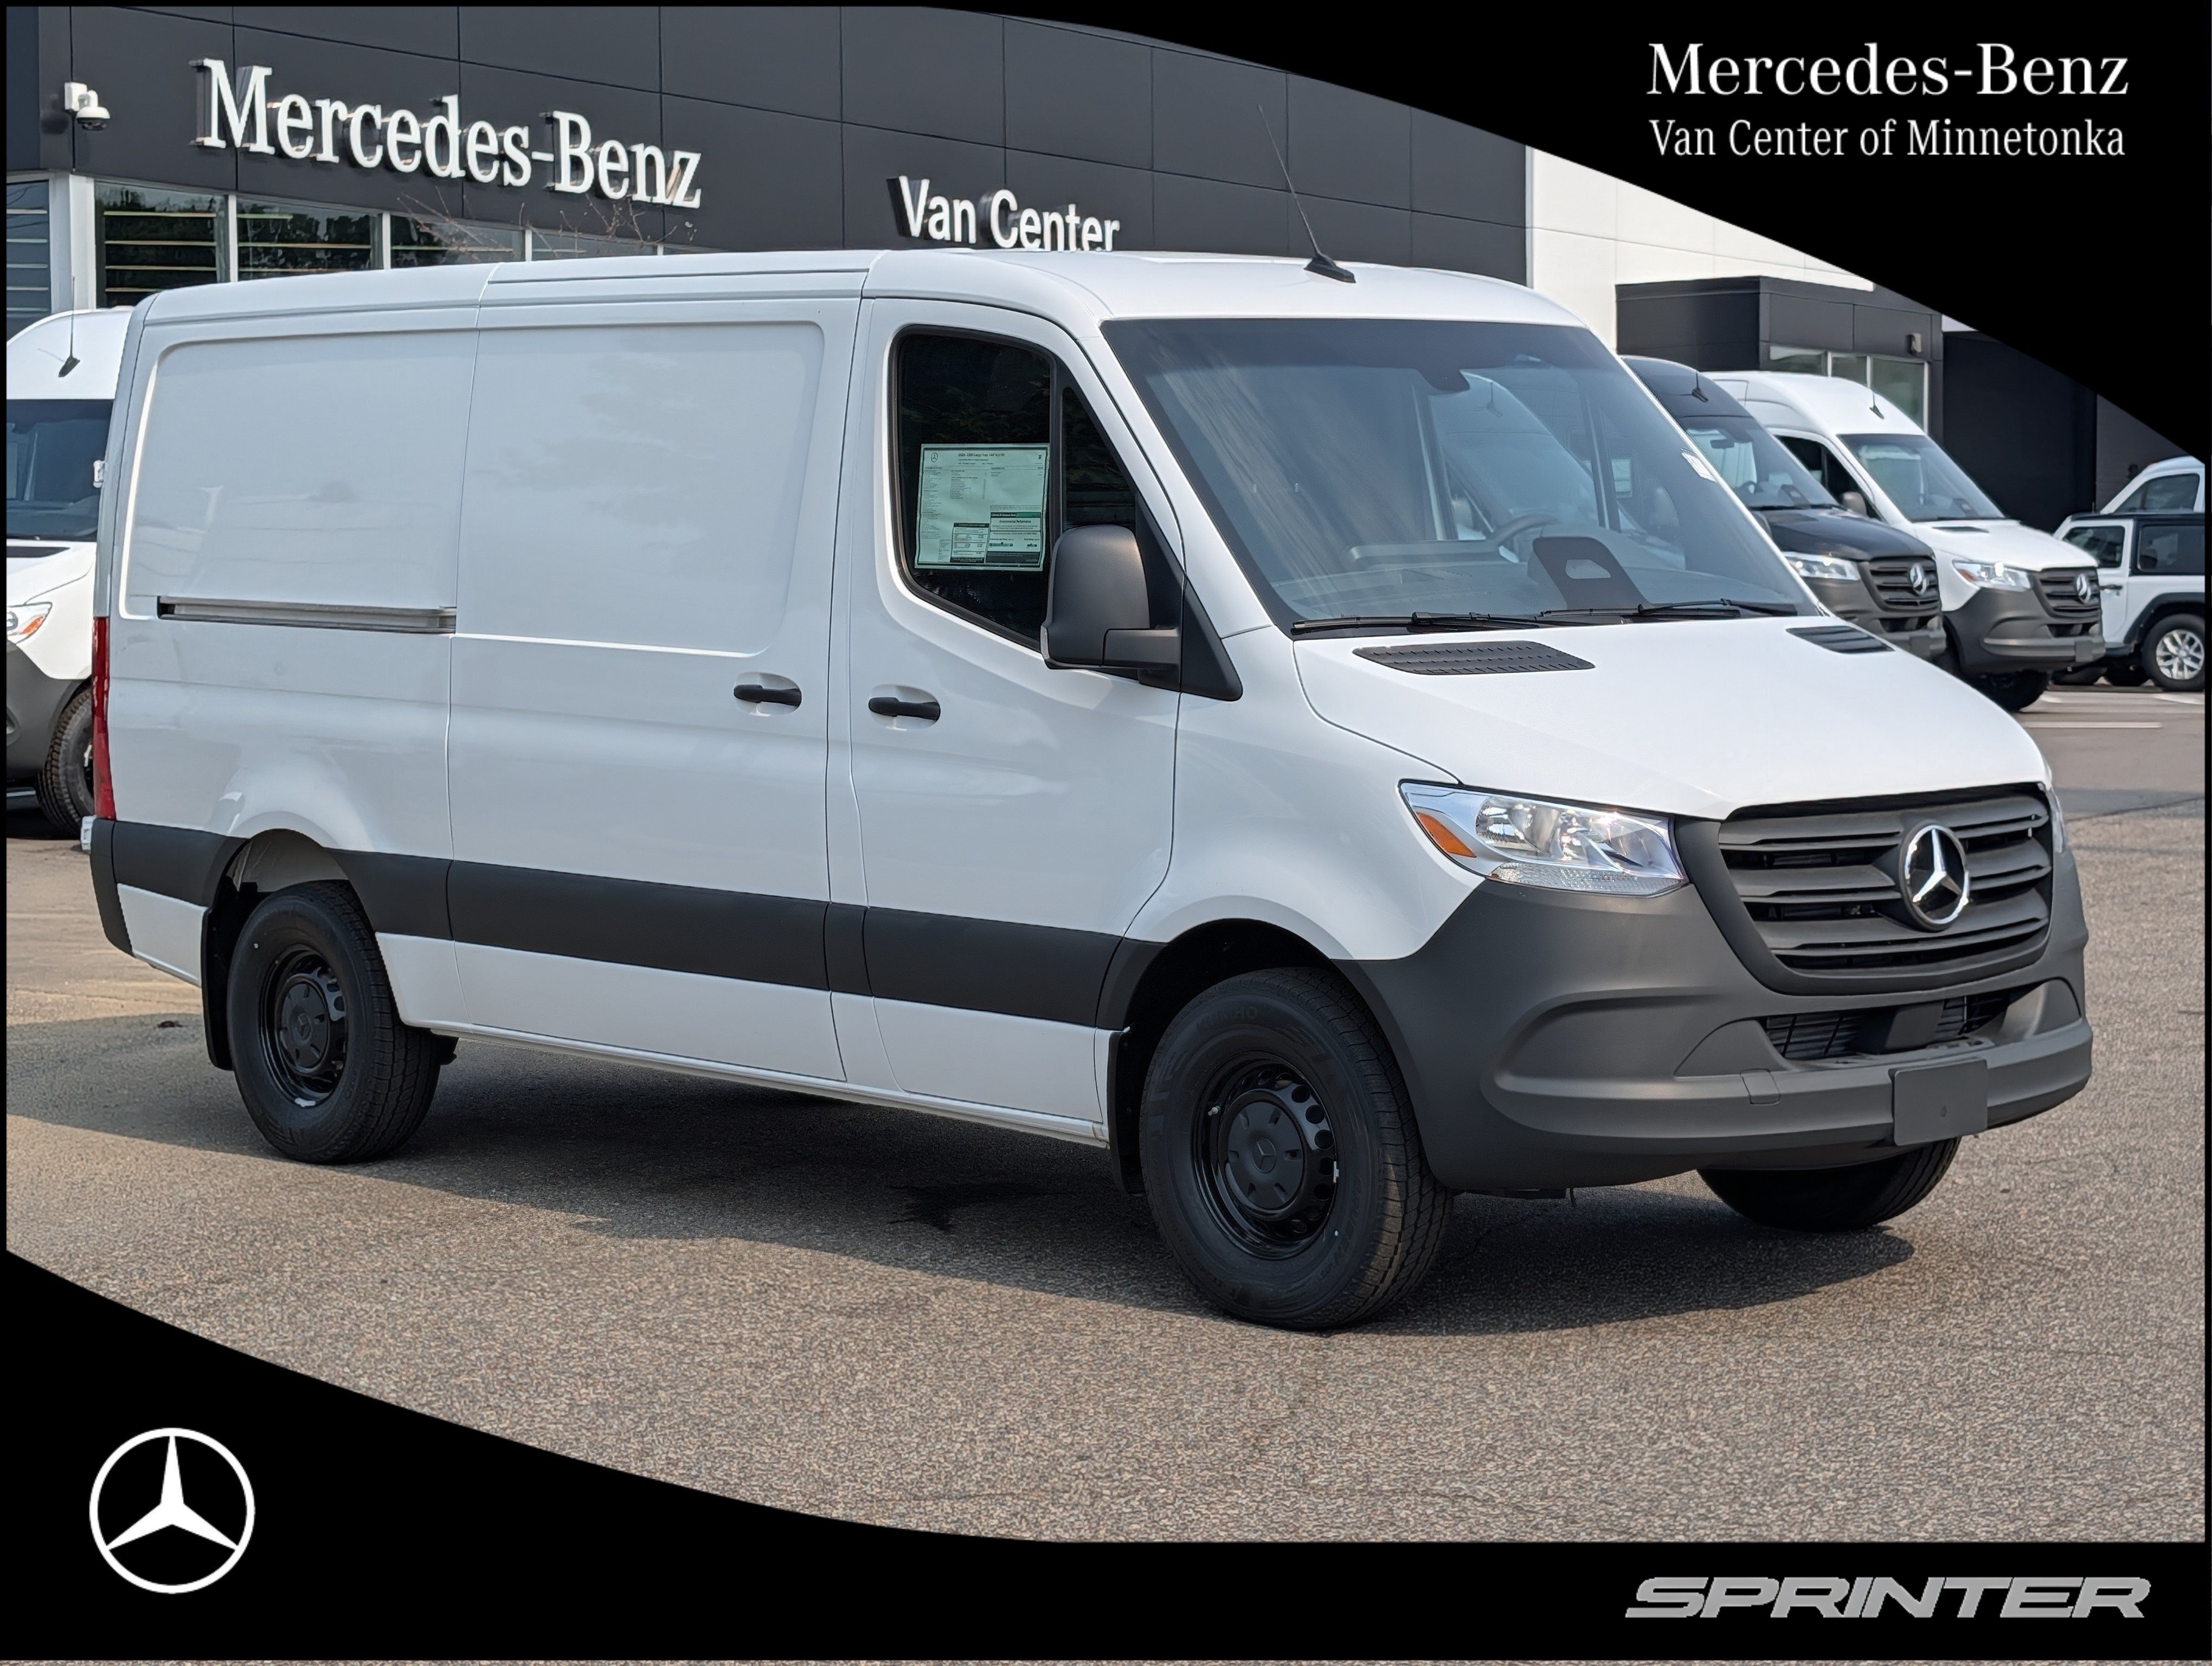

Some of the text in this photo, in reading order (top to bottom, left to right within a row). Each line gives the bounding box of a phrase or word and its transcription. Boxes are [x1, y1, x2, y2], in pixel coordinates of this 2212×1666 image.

[196, 57, 702, 209] Mercedes-Benz
[897, 175, 1121, 252] Van Center
